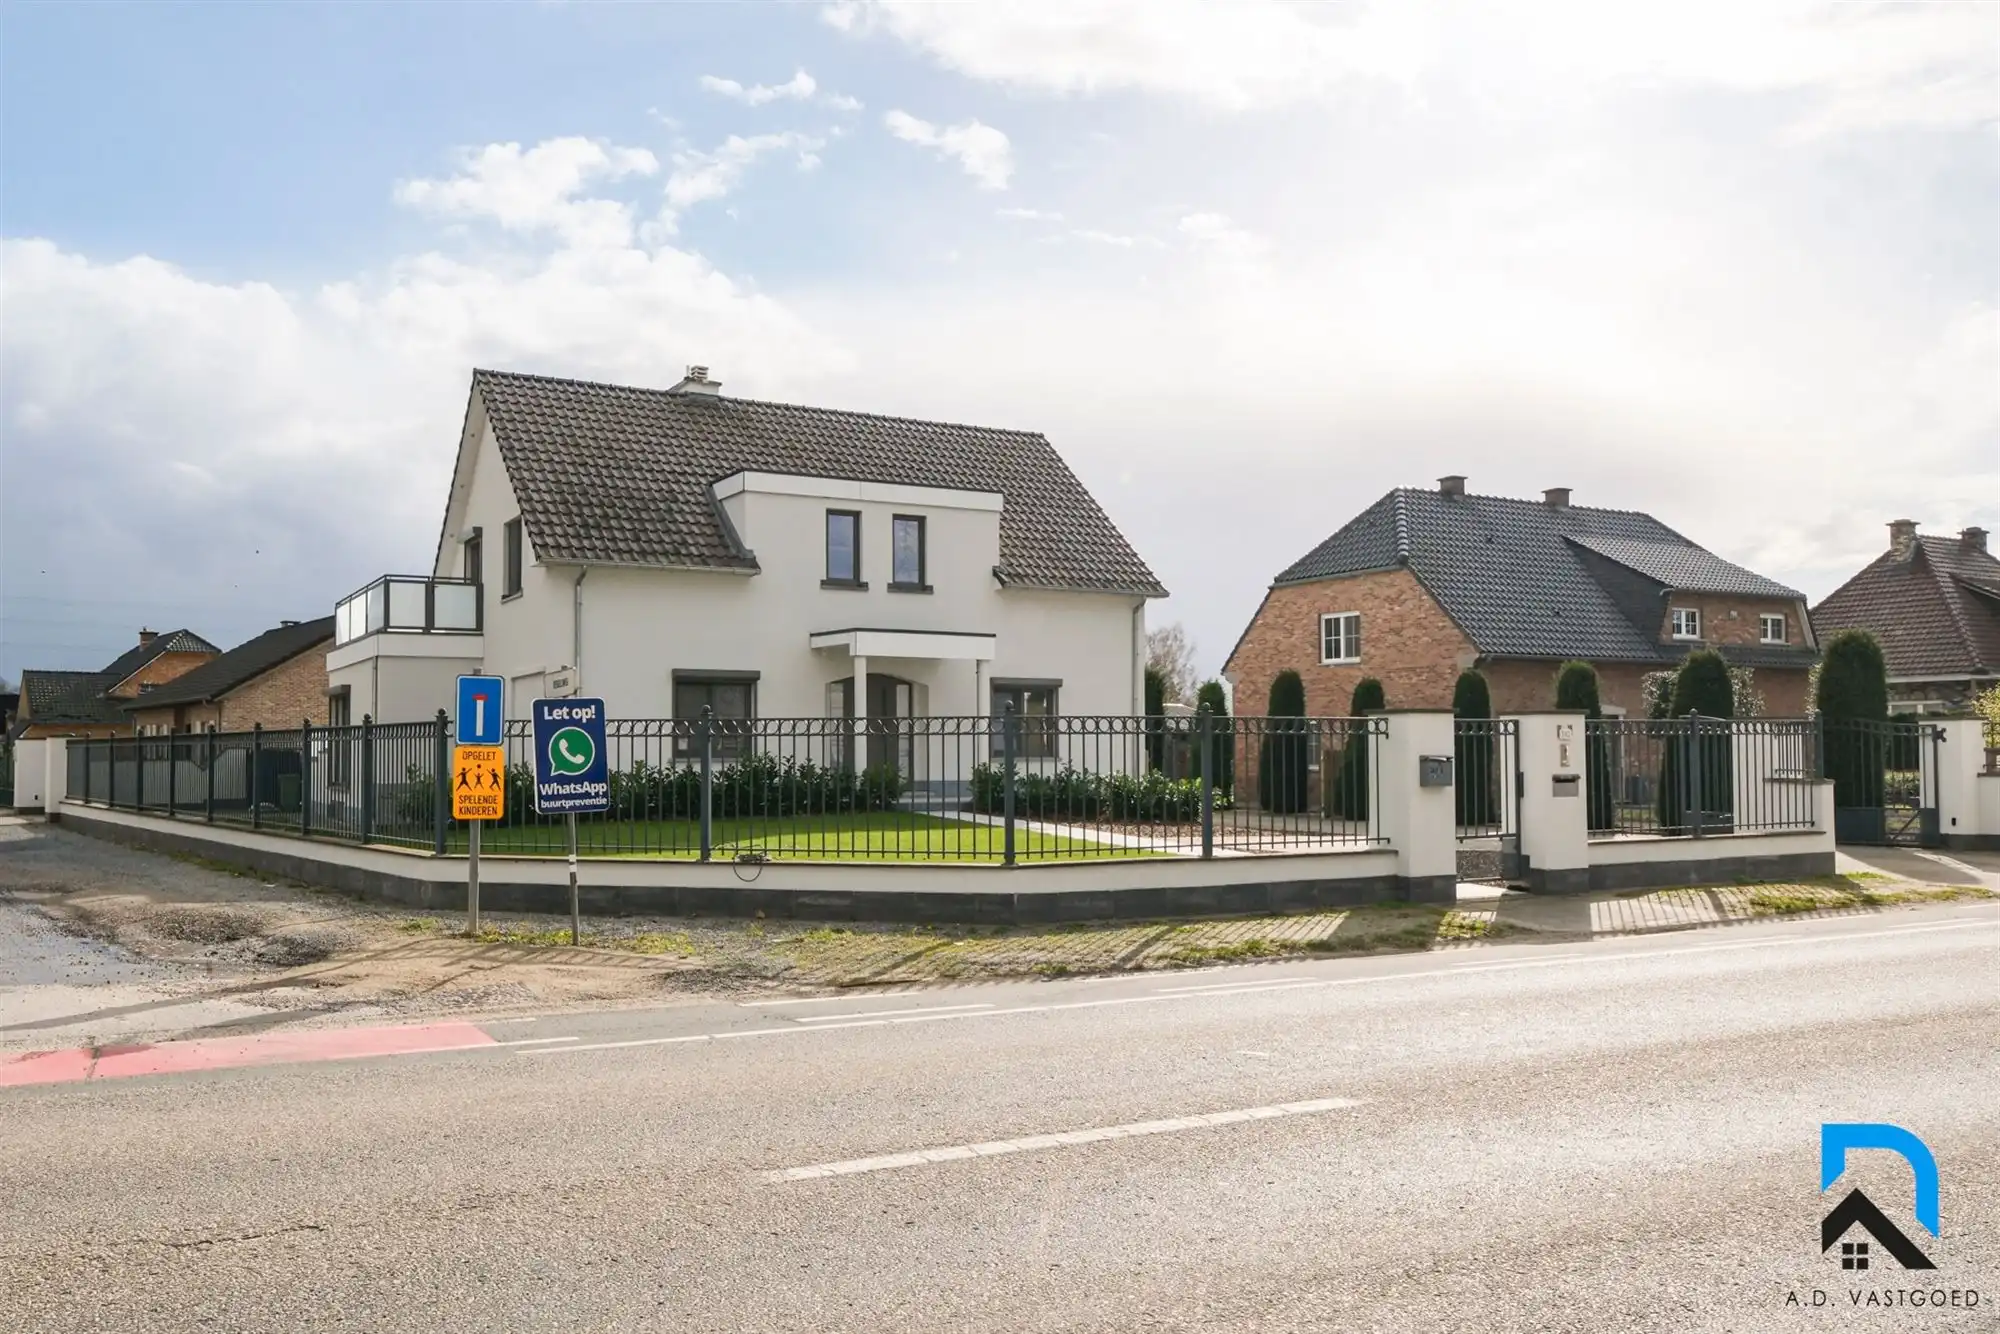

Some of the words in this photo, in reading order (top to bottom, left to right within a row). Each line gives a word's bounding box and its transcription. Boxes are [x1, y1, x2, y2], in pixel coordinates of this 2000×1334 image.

[544, 706, 569, 720] Let
[572, 704, 596, 723] op!
[462, 751, 496, 761] OPGELET
[539, 781, 607, 796] WhatsApp
[459, 795, 498, 804] SPELENDE
[541, 796, 607, 809] buurtpreventie
[458, 806, 498, 816] KINDEREN
